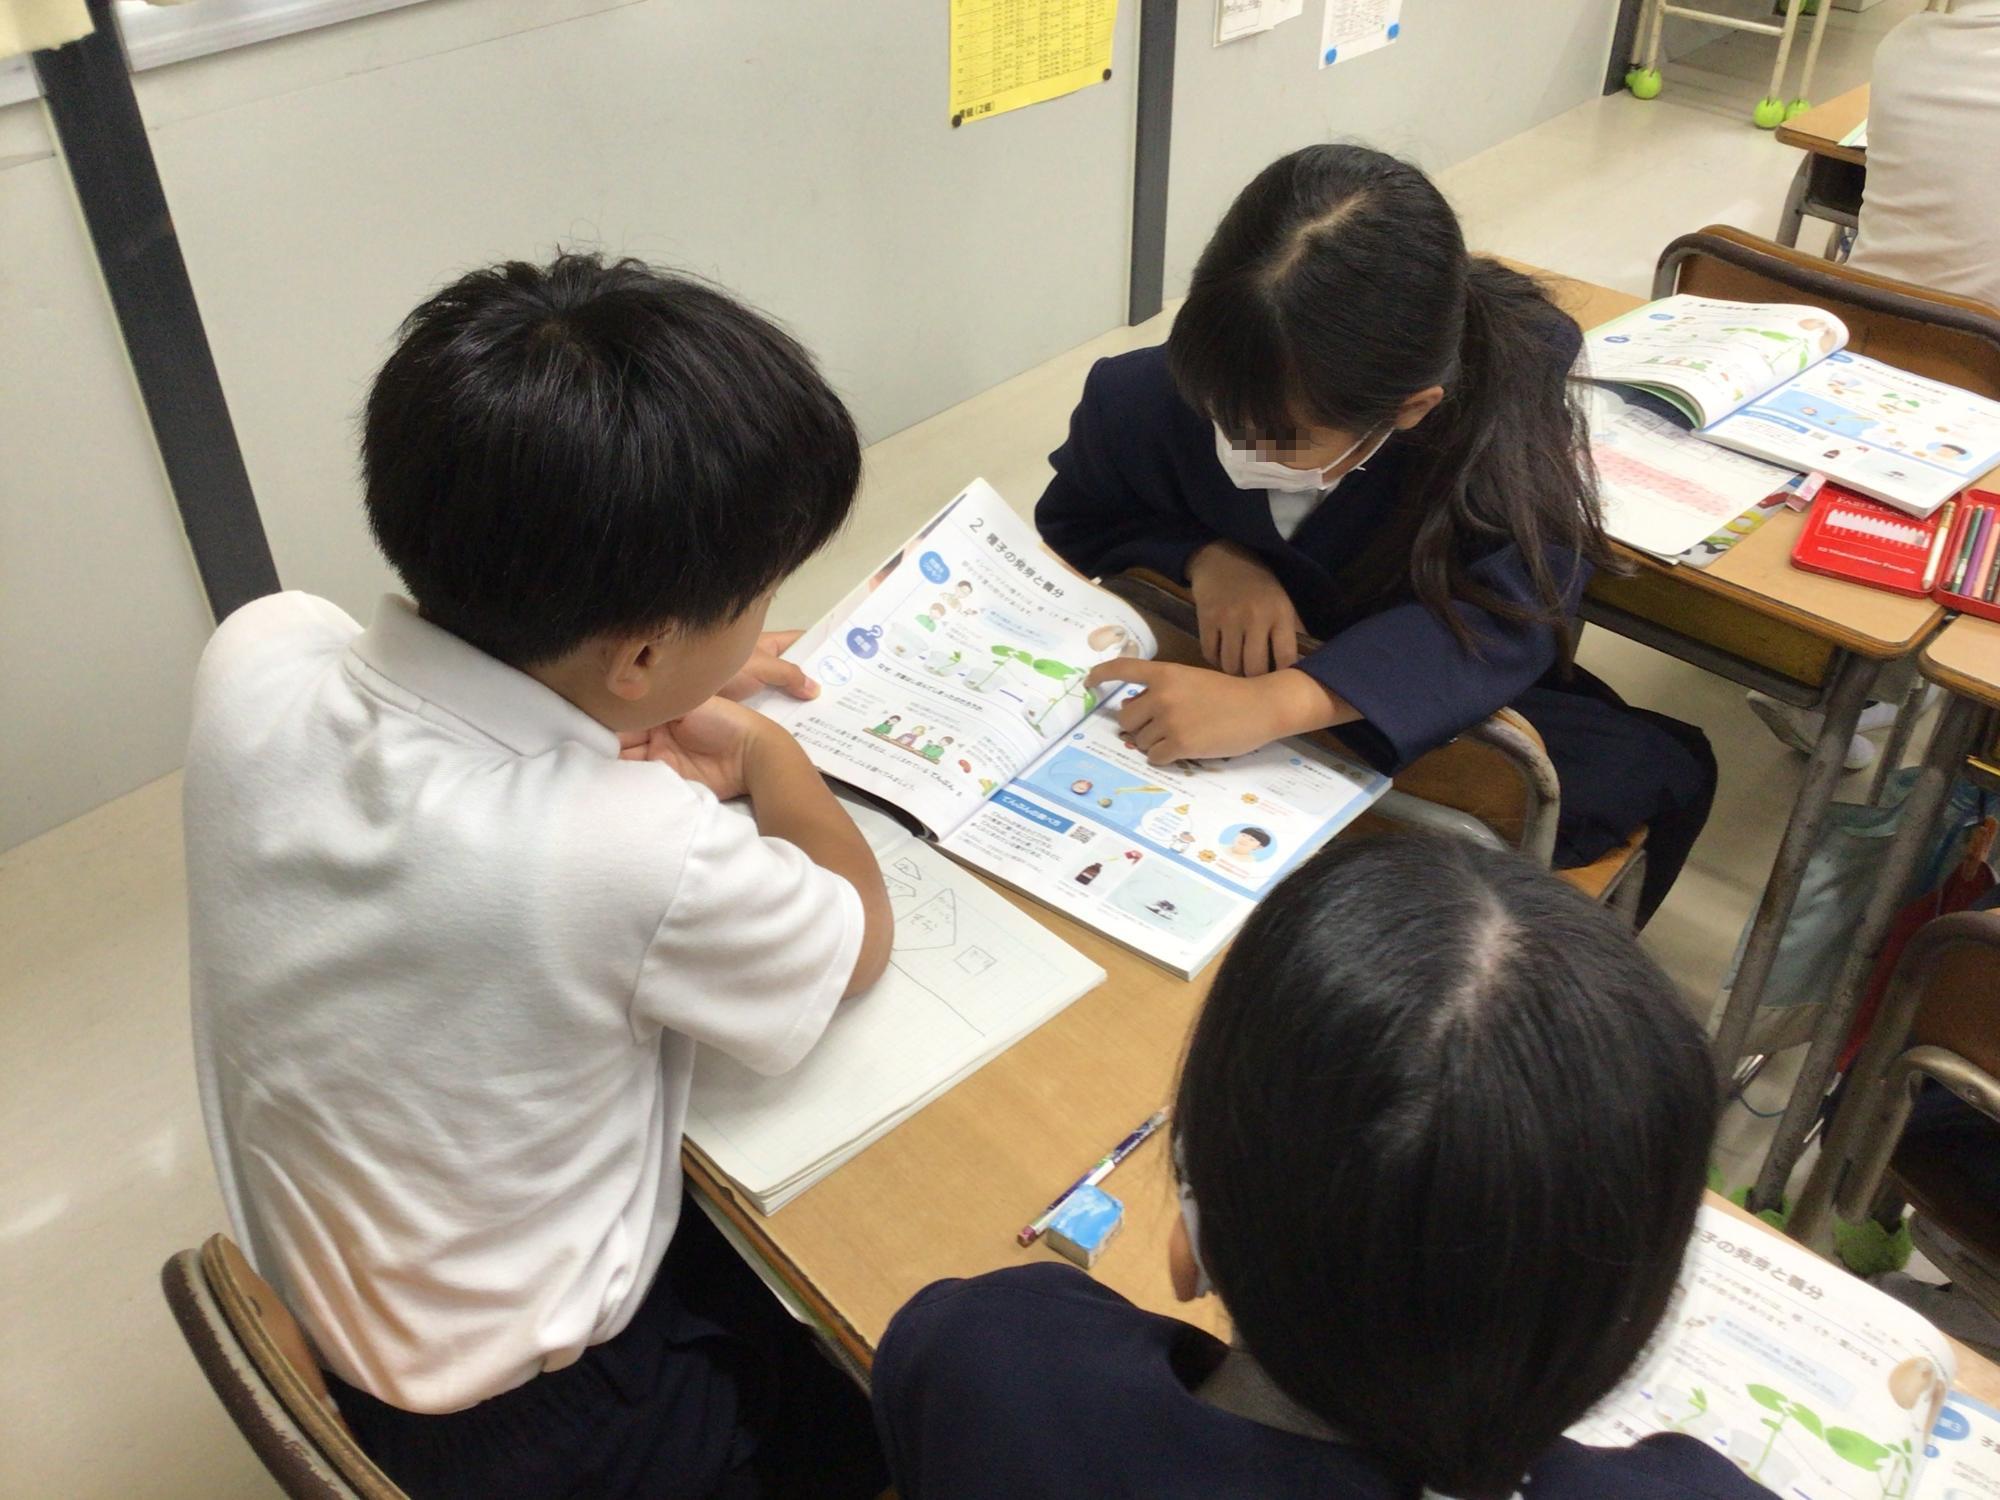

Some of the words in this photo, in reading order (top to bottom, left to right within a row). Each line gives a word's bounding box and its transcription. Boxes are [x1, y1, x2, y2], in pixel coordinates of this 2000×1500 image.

[969, 517, 984, 533] 2
[986, 532, 1065, 599] 種子の発芽と養分
